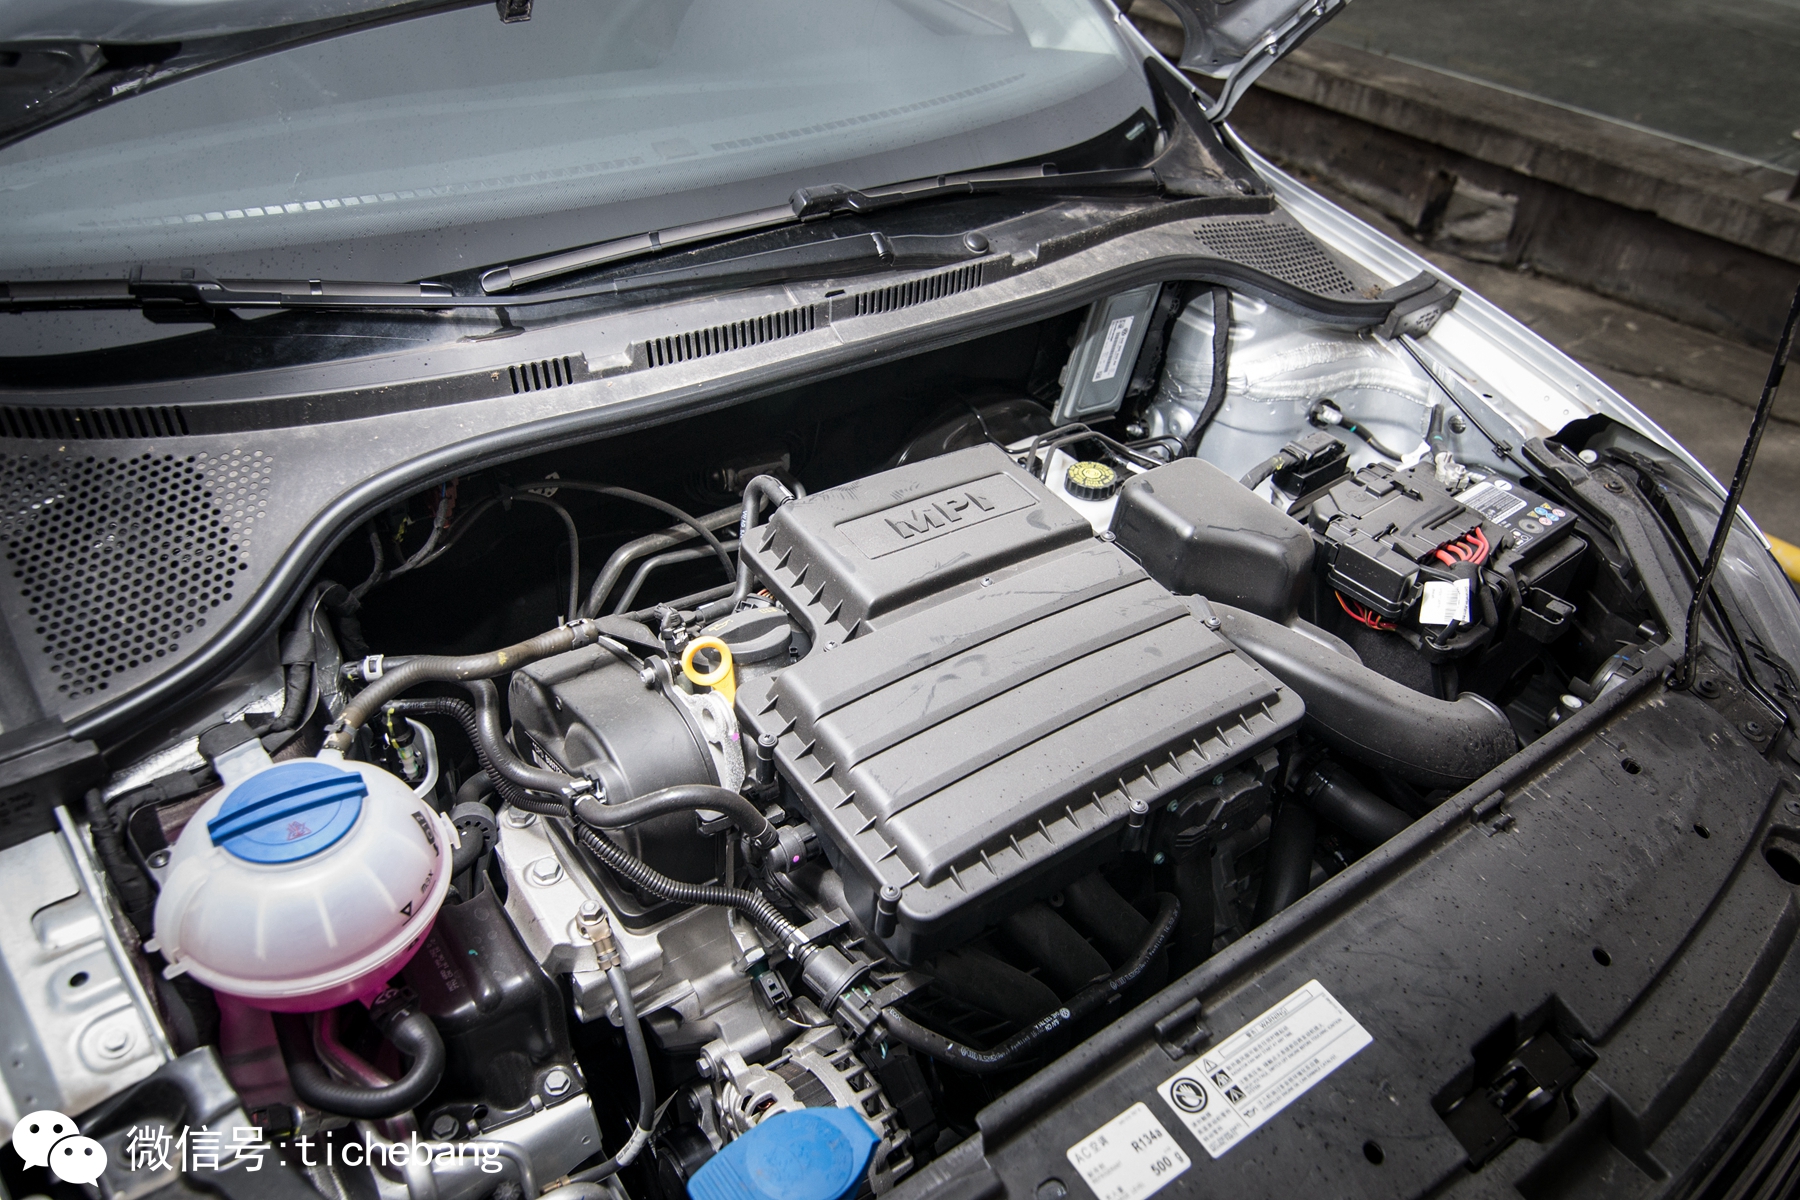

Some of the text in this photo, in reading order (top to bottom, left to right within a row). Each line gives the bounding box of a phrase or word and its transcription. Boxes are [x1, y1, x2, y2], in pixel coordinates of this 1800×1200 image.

[884, 492, 995, 539] MPI
[1131, 1128, 1163, 1154] R134a
[1150, 1151, 1184, 1177] 500 g
